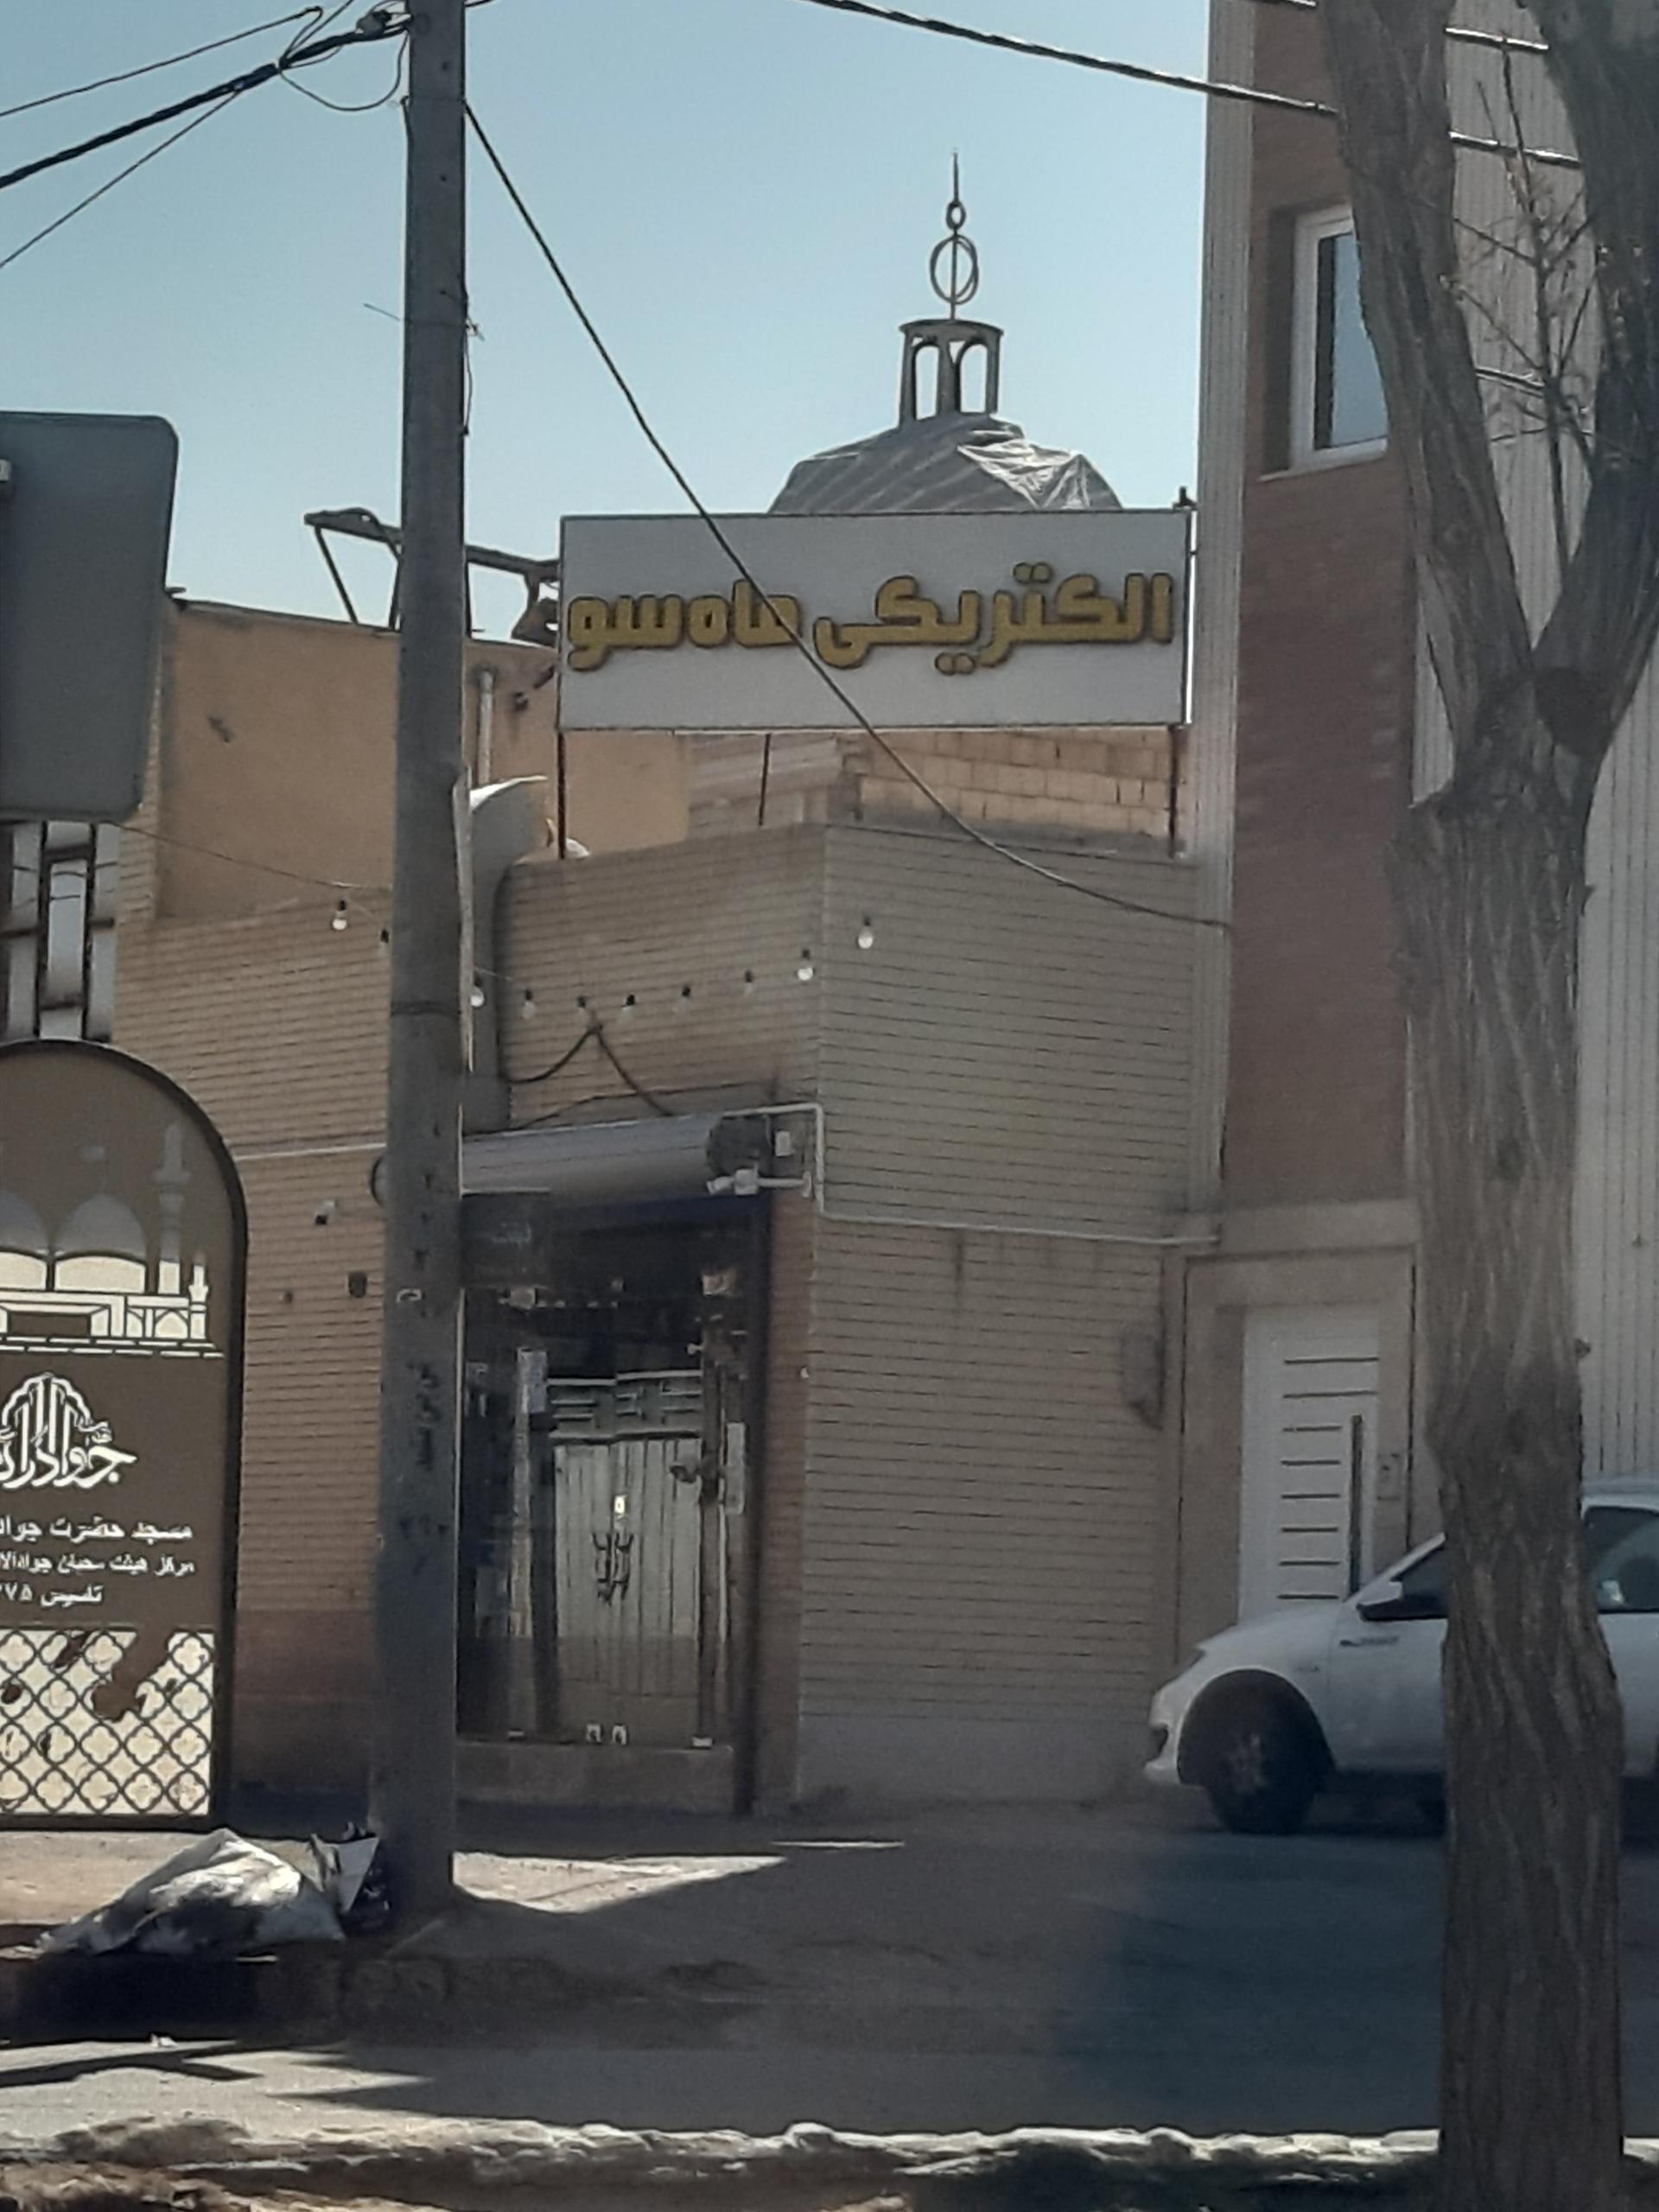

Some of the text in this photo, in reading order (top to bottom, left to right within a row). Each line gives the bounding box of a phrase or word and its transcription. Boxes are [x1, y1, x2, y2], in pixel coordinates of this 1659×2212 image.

[813, 562, 1173, 676] الکتریکی
[49, 1515, 125, 1544] حضرت
[130, 1521, 193, 1545] مسجد
[154, 1554, 195, 1577] مرکز
